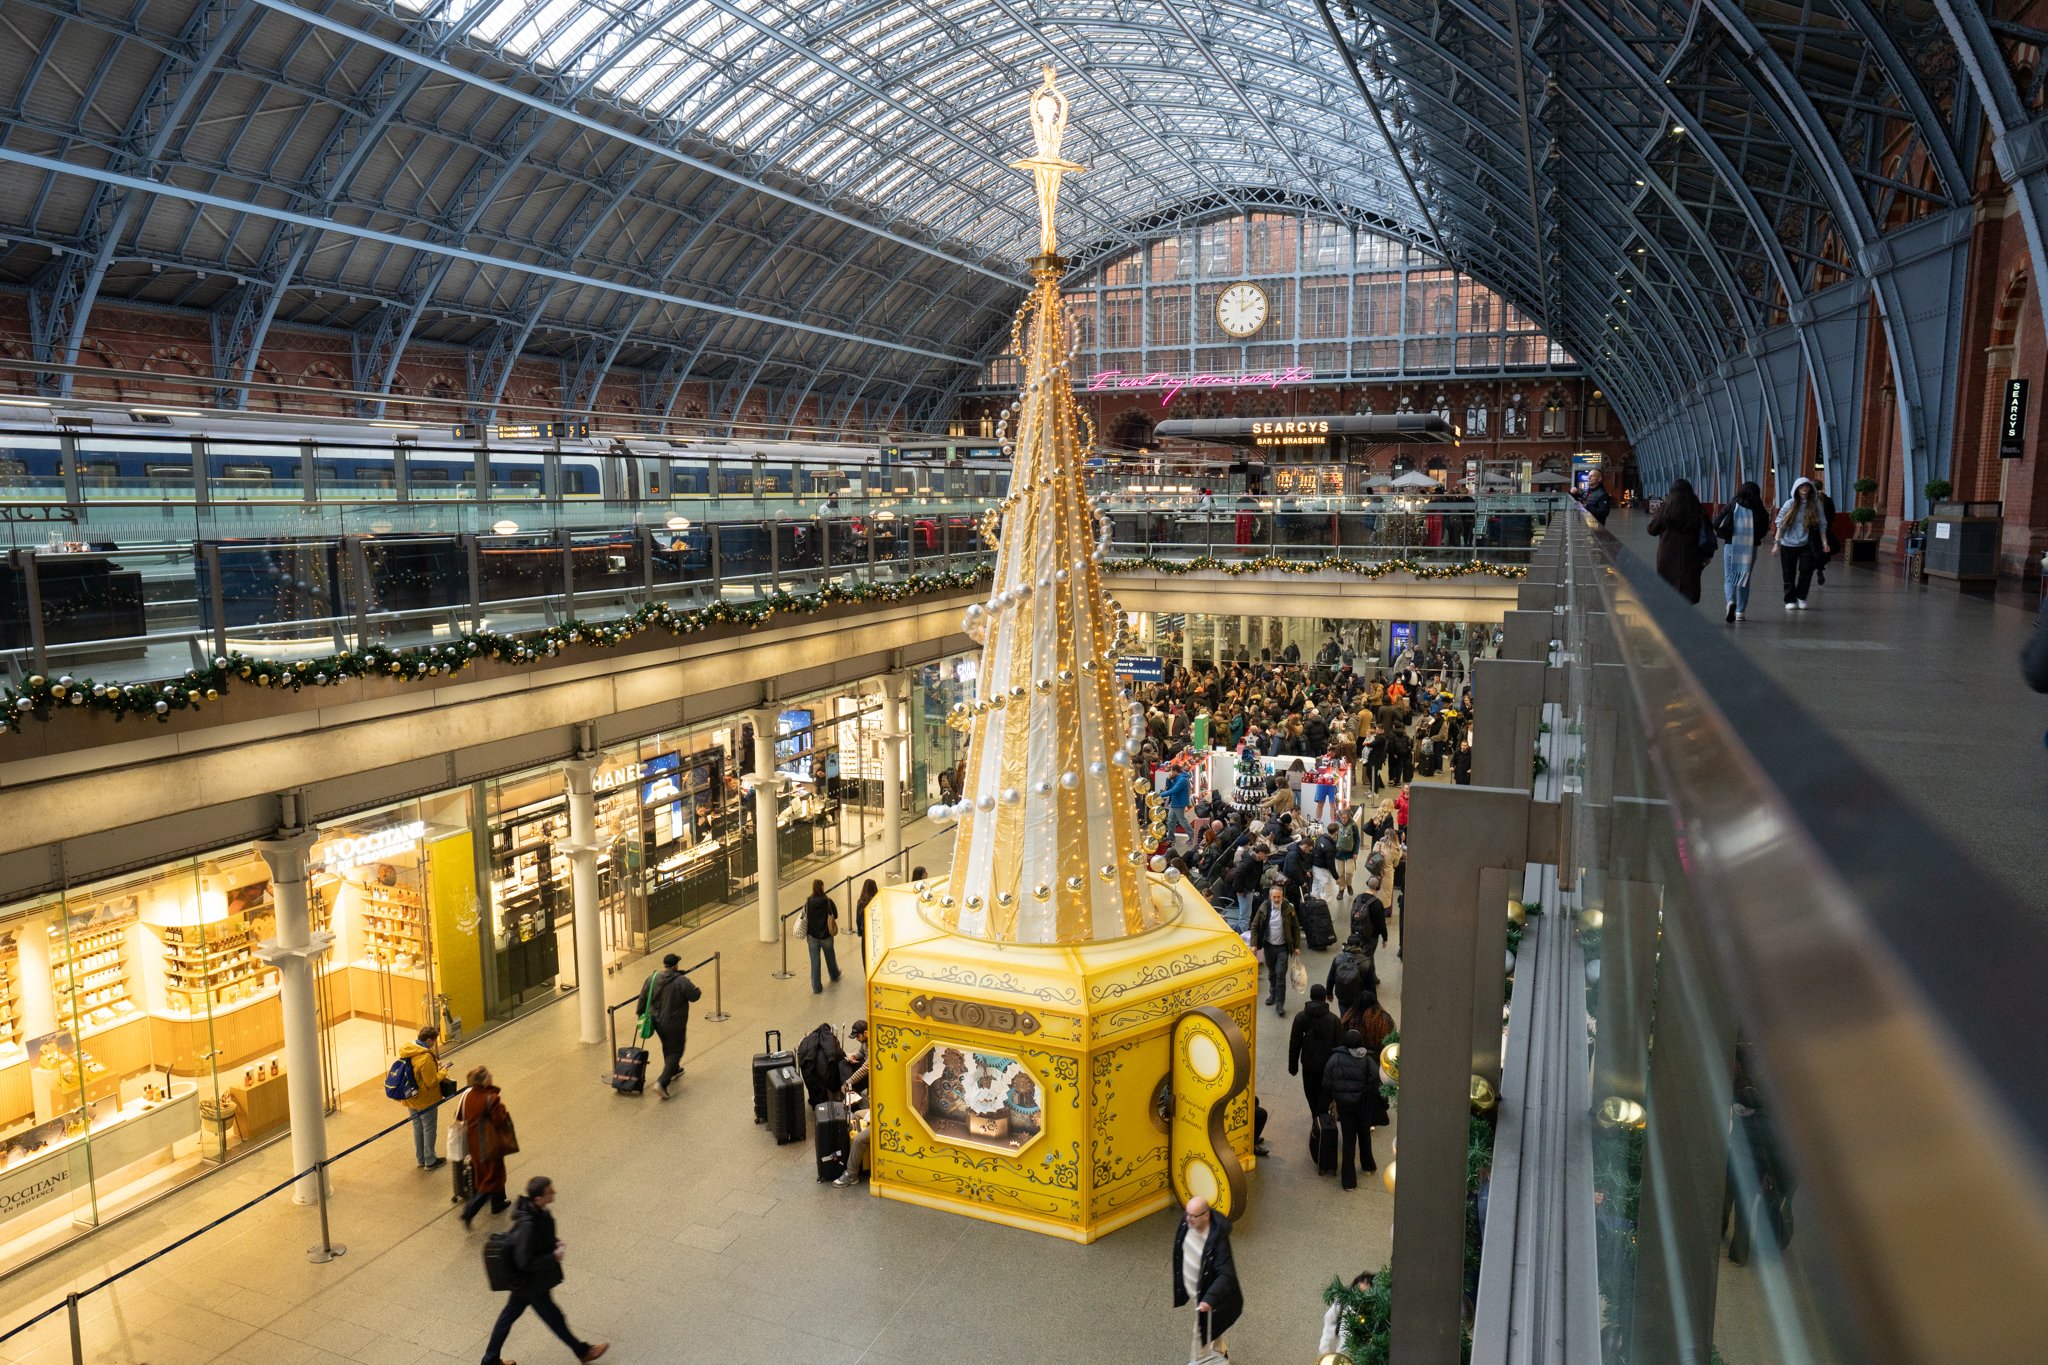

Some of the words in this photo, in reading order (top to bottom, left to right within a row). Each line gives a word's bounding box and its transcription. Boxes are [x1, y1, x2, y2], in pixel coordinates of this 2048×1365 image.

[1088, 371, 1121, 391] I
[2008, 382, 2021, 437] SEARCYS
[1252, 421, 1329, 434] SEARCYS
[1256, 437, 1273, 445] BAR
[1282, 437, 1326, 445] BRASSERIE
[592, 763, 646, 792] HANEL
[0, 1170, 69, 1209] OCCITANE
[3, 1206, 14, 1214] EN
[16, 1187, 55, 1208] PROVENCE
